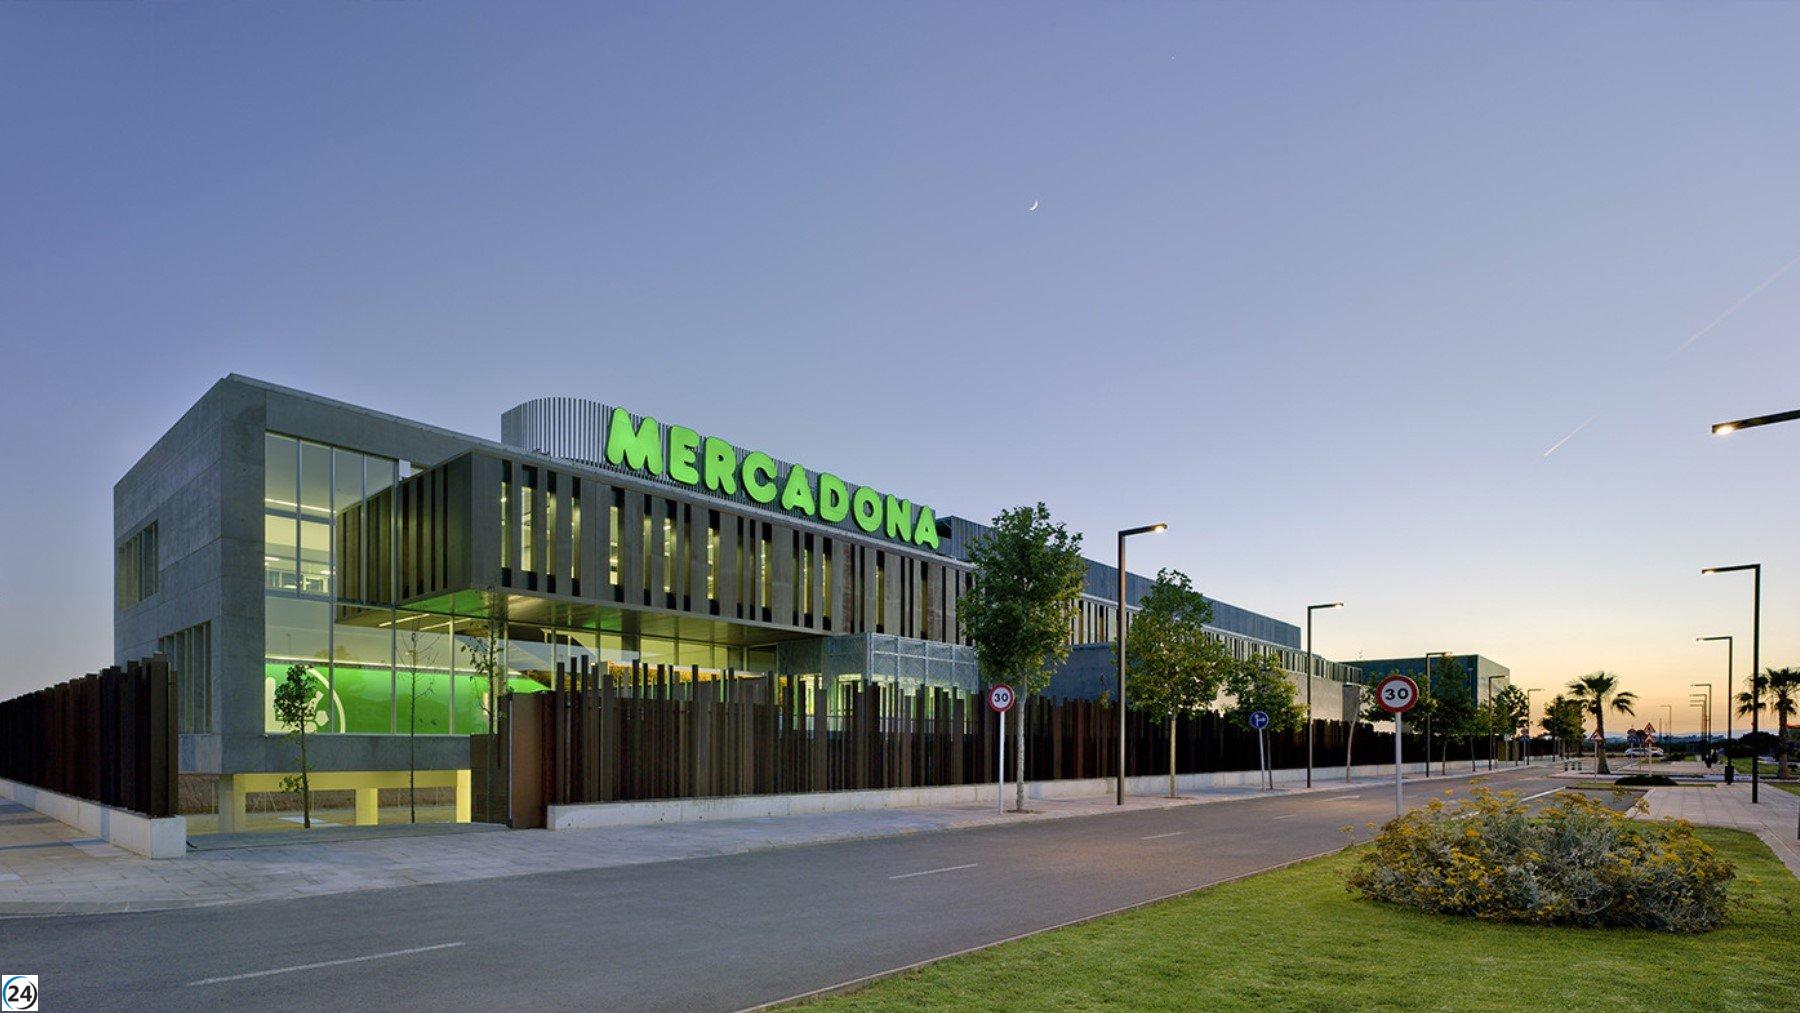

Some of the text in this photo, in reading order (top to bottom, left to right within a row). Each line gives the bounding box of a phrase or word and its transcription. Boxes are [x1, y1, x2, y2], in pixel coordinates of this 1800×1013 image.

[605, 406, 940, 550] MERCADONA
[995, 693, 1009, 702] 30
[1385, 688, 1409, 701] 30
